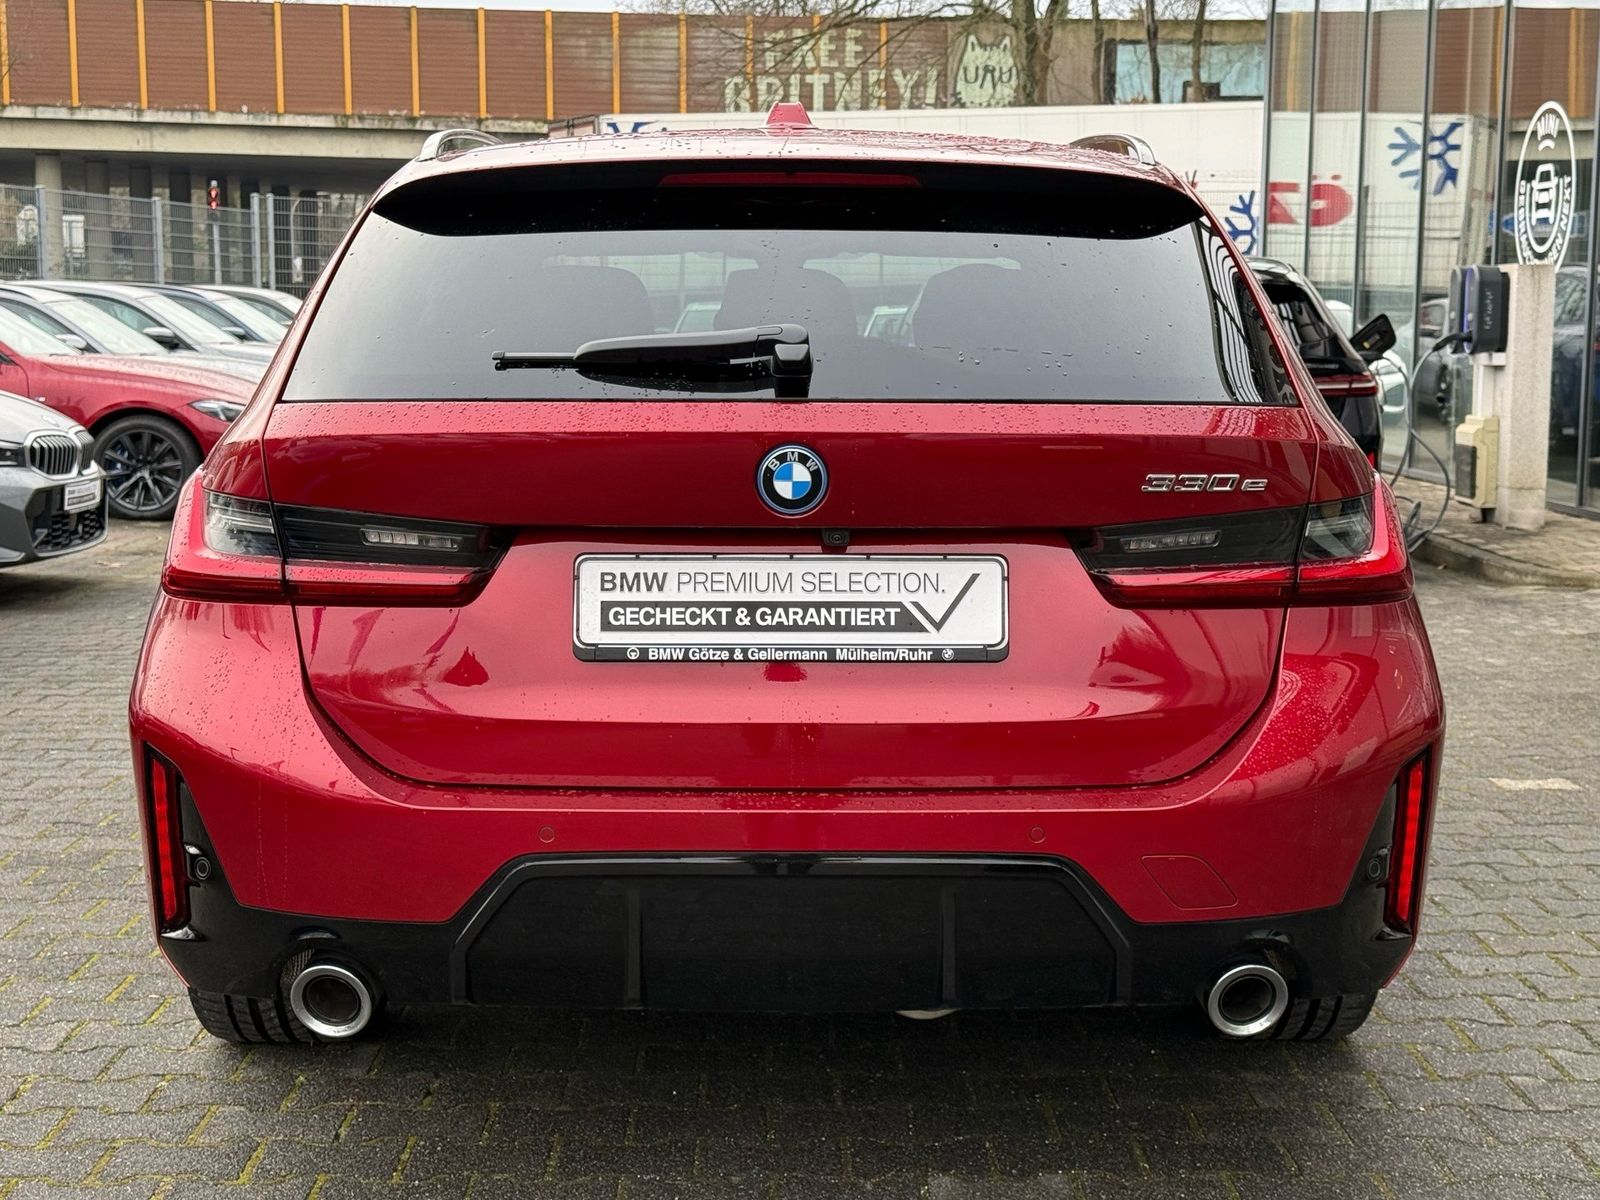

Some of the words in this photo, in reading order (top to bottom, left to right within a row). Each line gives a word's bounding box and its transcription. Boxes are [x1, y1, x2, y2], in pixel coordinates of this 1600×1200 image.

[763, 28, 864, 72] FREE
[1537, 113, 1560, 141] MINI
[767, 451, 819, 472] BMW
[1141, 474, 1268, 492] 330e
[600, 572, 668, 592] BMW
[677, 572, 793, 593] PREMIUM
[800, 572, 946, 594] SELECTION.
[608, 607, 732, 626] GECHECKT
[735, 607, 751, 626] &
[755, 607, 901, 626] GARANTIERT
[648, 649, 685, 660] BMW
[688, 648, 730, 661] Götze
[733, 649, 744, 660] &
[748, 648, 828, 661] Gellermann
[835, 648, 933, 661] Mülheim/Ruhr
